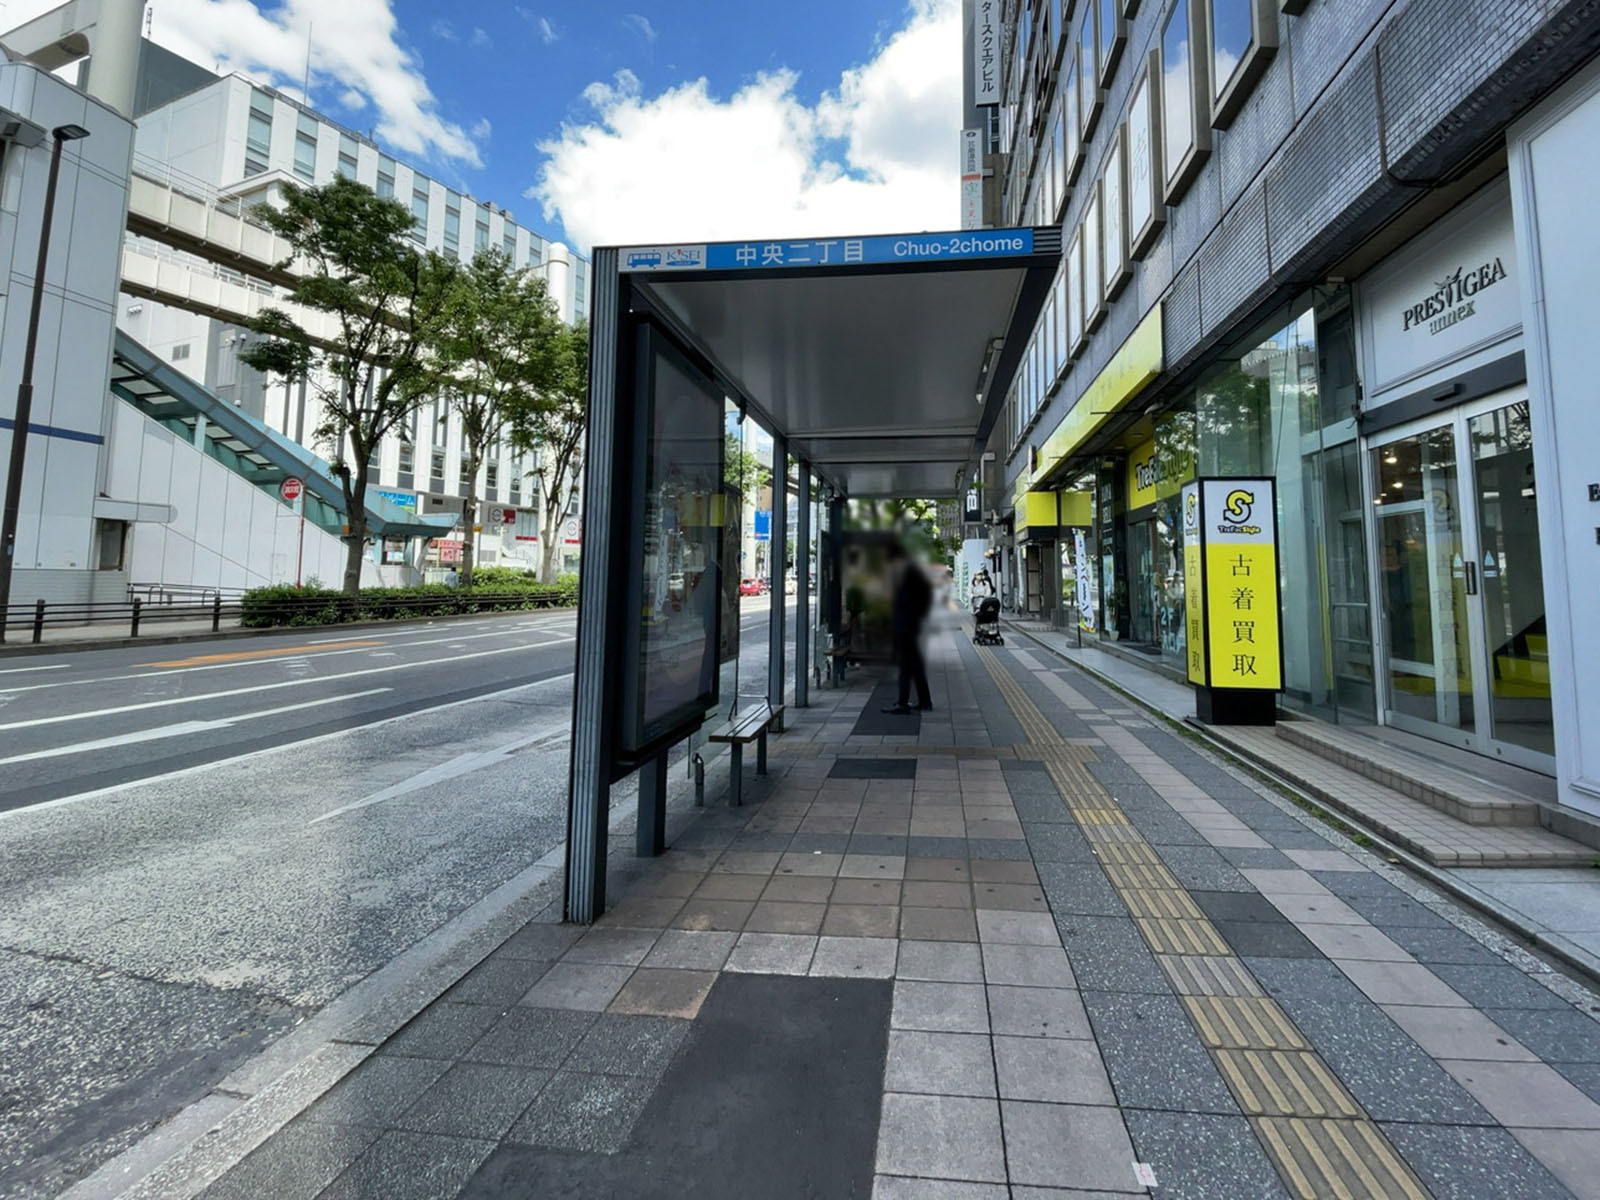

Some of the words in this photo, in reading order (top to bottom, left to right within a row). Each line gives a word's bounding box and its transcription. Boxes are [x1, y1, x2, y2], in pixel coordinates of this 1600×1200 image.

[735, 240, 864, 266] 中央二丁目
[894, 236, 1023, 256] Chuo-2chome
[1160, 607, 1174, 626] 2F
[1229, 554, 1257, 676] 古着買取
